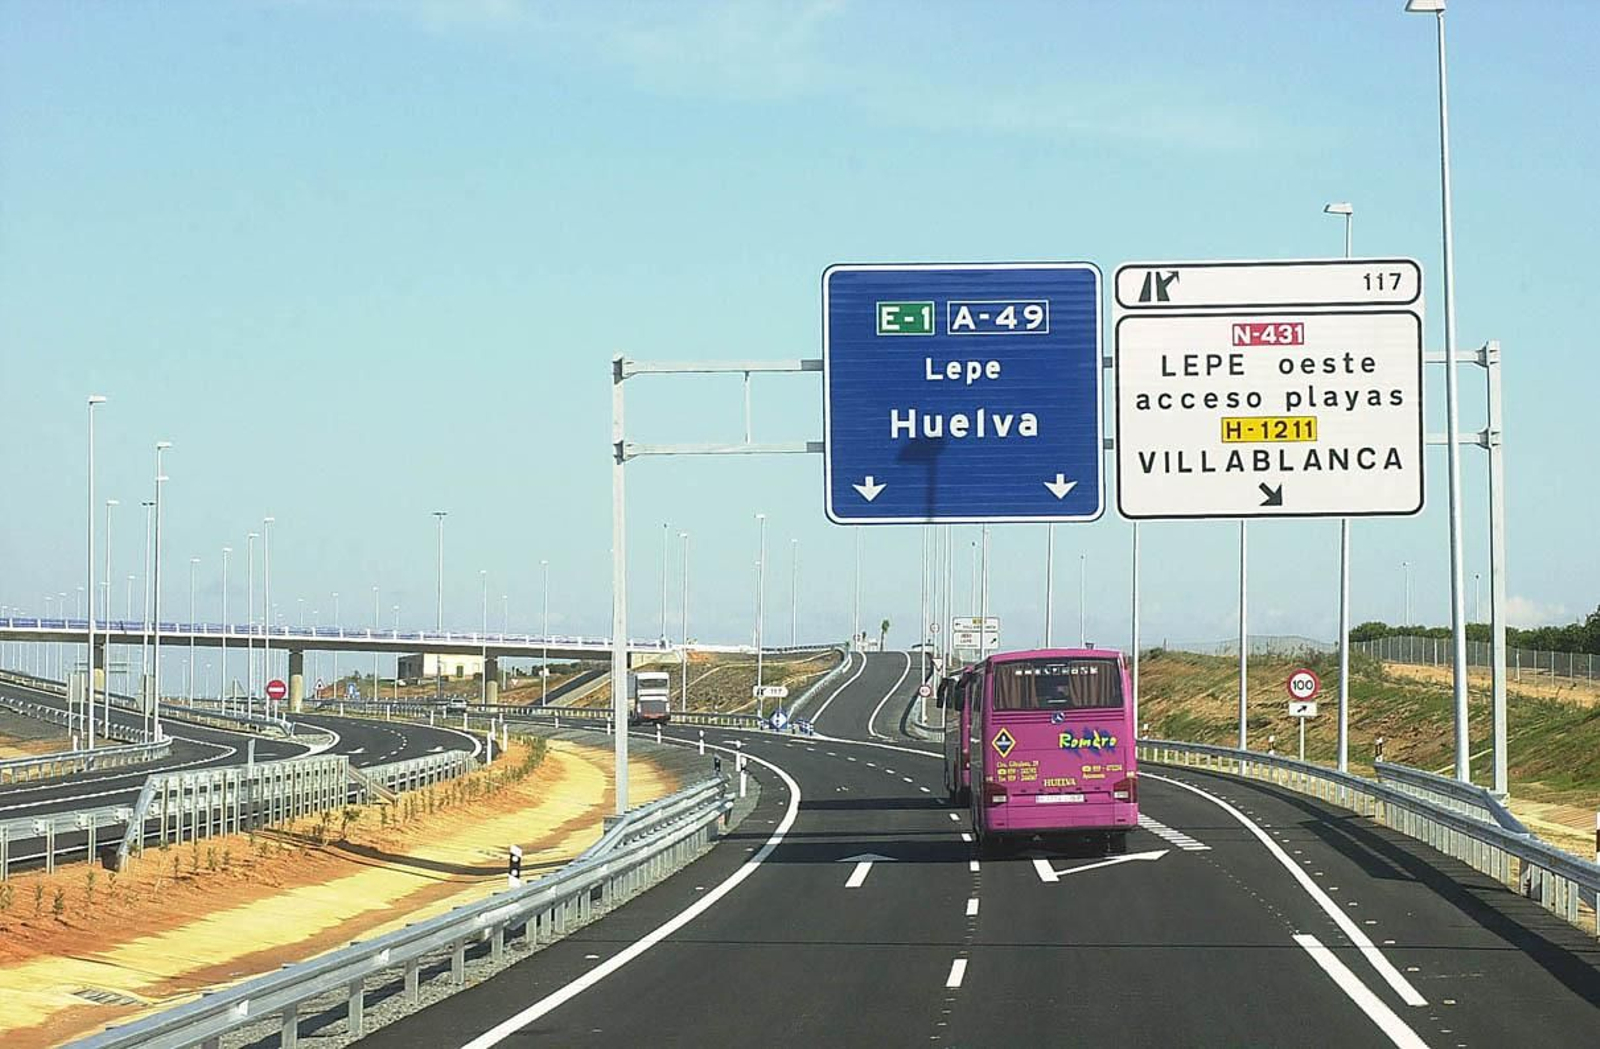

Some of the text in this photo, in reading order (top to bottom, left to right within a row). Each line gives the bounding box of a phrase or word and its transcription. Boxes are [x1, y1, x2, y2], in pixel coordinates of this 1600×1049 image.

[1363, 272, 1402, 290] 117
[881, 305, 1044, 330] E-1 A-49
[1233, 325, 1303, 345] N-431
[925, 357, 1001, 384] Lepe
[1161, 352, 1376, 376] LEPE oeste
[1135, 385, 1404, 411] acceso playas
[890, 408, 1038, 439] Huelva
[1225, 420, 1314, 440] H-1211
[1139, 447, 1403, 473] VILLABLANCA
[1293, 679, 1313, 690] 100
[1059, 729, 1117, 750] Romero
